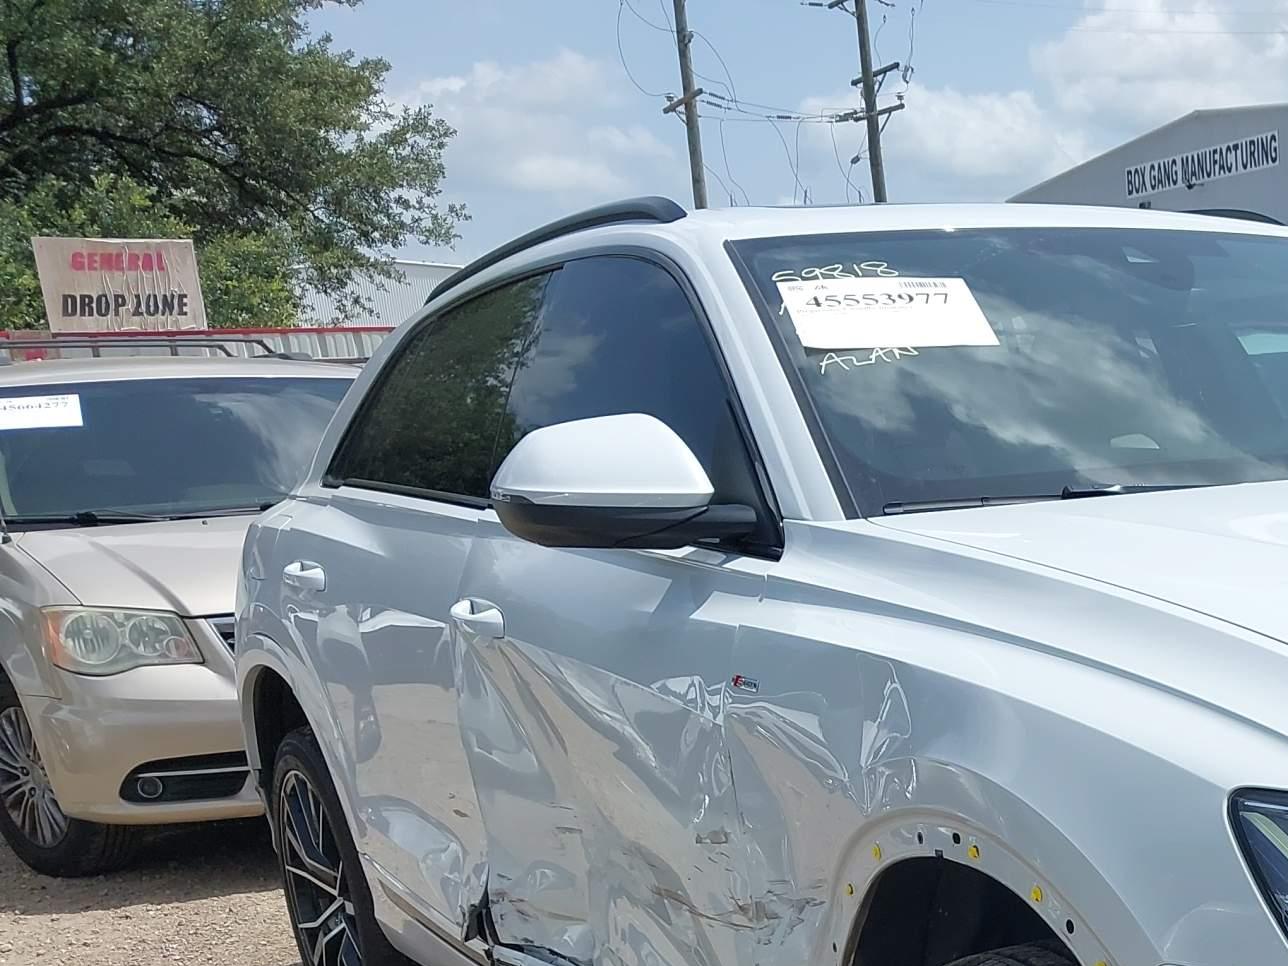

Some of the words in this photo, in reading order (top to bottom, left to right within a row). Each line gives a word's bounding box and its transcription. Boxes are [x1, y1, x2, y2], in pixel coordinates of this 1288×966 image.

[1126, 166, 1148, 196] BOX
[1149, 158, 1179, 192] GANG
[1181, 133, 1279, 184] MANUFACTURING
[71, 250, 166, 272] GENERAL
[61, 293, 127, 318] DROP
[131, 293, 189, 317] ZONE
[805, 292, 949, 308] 45553977
